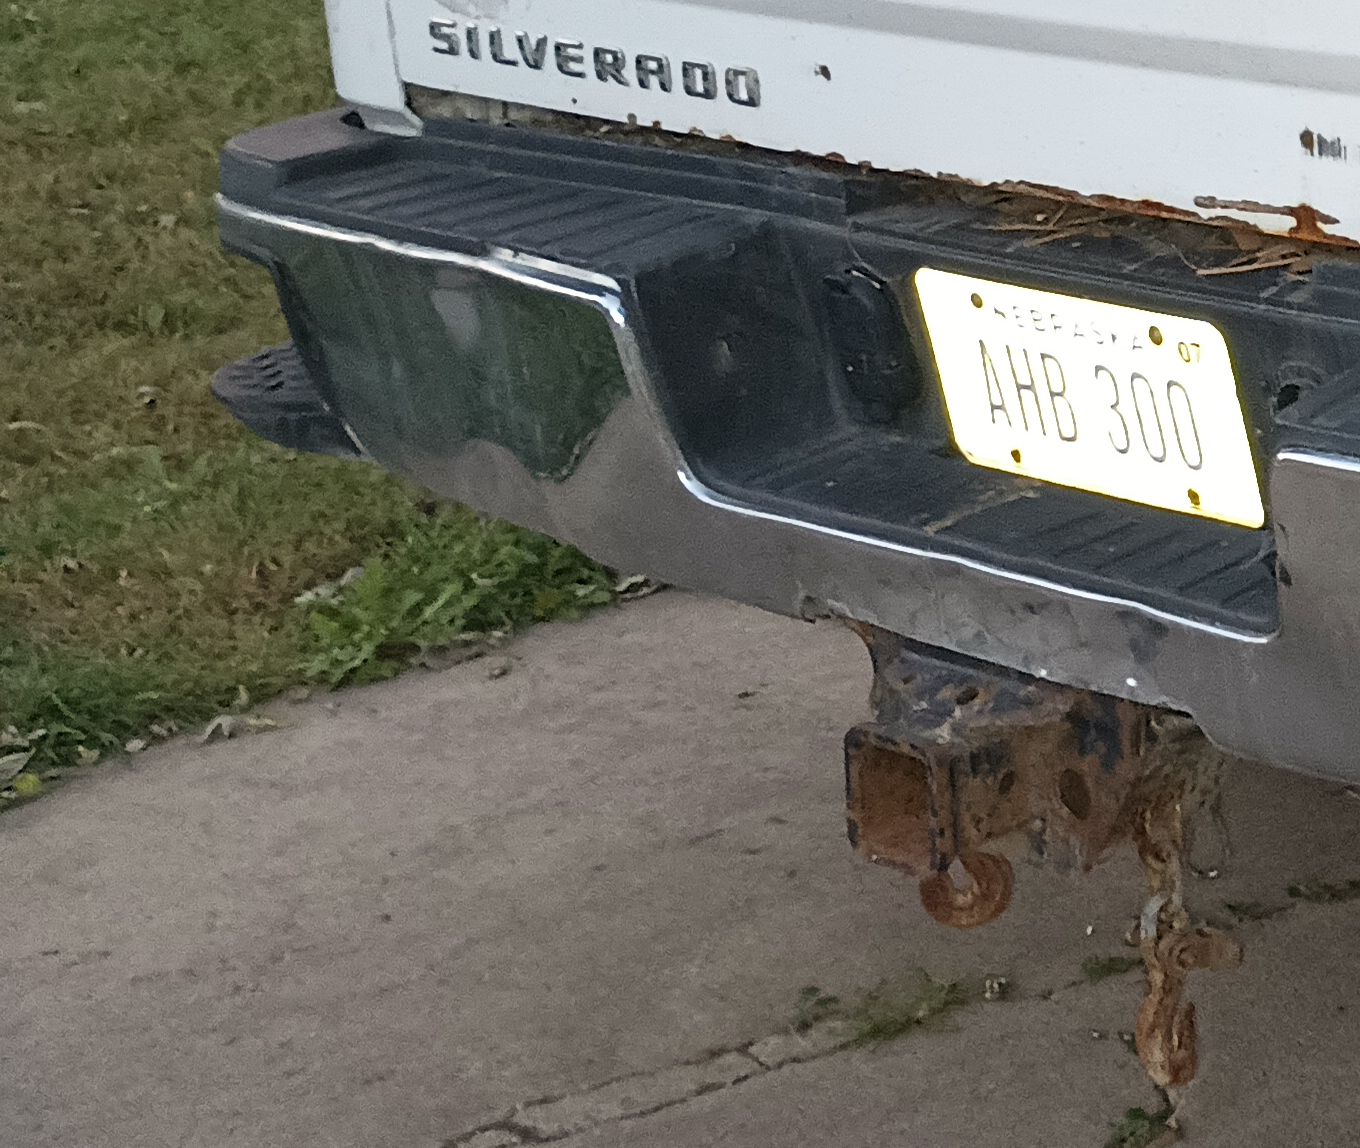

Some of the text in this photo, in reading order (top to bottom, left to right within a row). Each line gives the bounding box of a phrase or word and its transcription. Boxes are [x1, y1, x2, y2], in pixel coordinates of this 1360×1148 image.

[428, 16, 762, 108] SILVERADO
[1177, 341, 1202, 364] 07
[979, 339, 1203, 471] AHB 300
